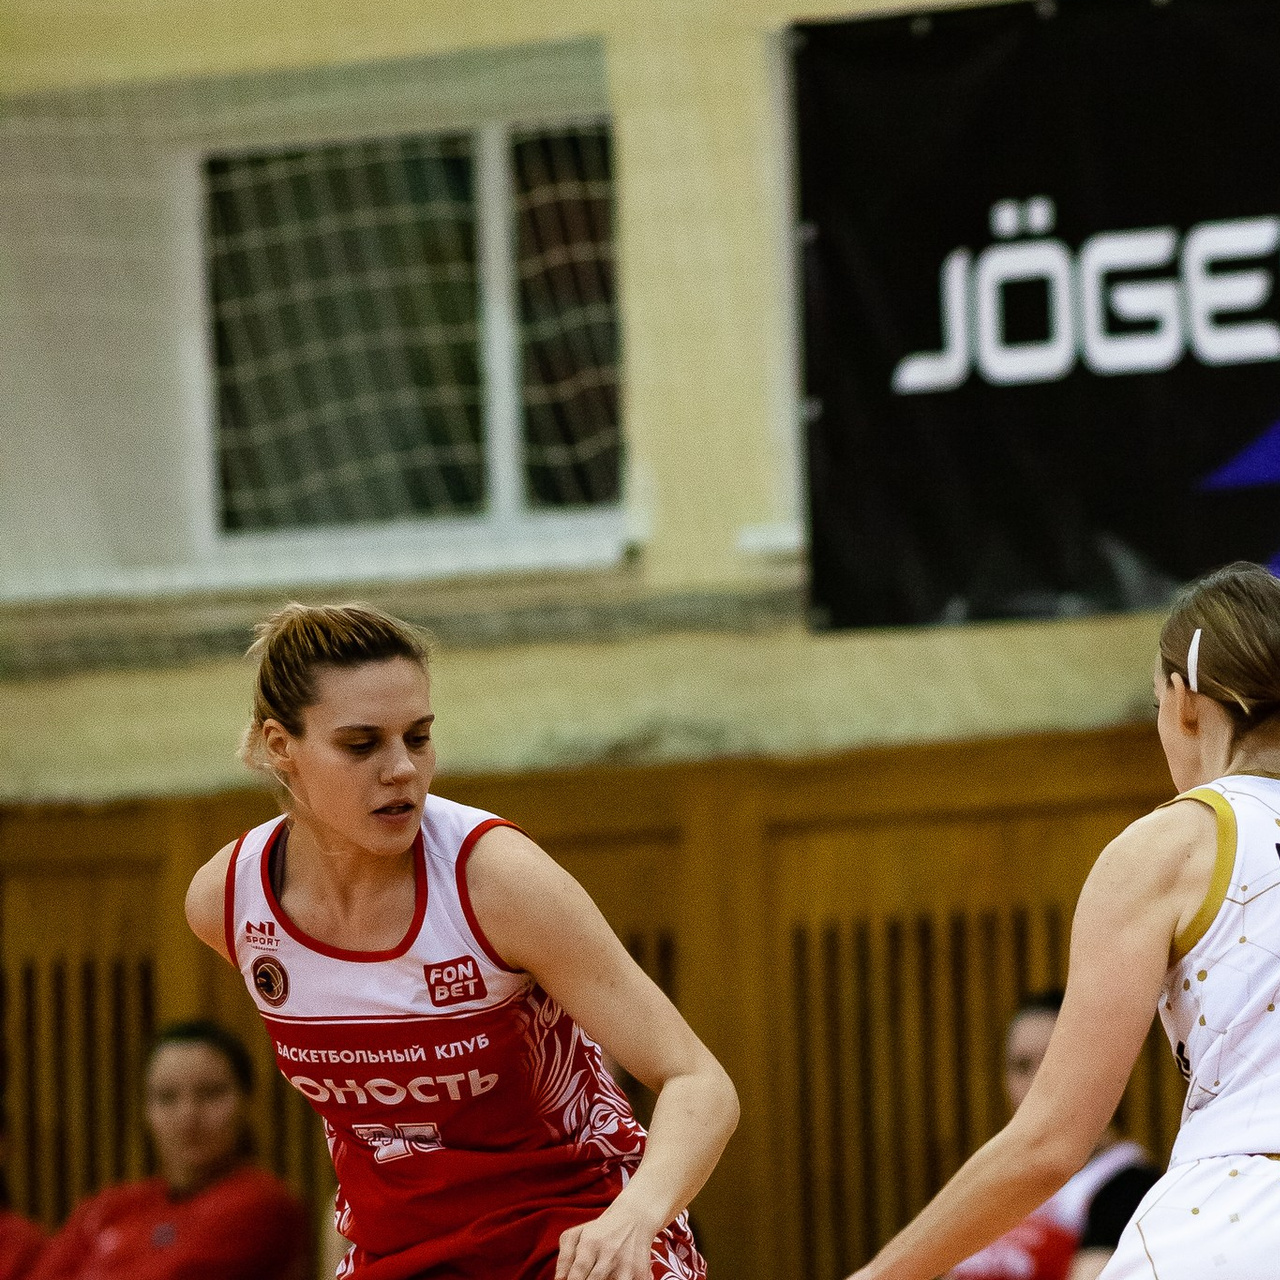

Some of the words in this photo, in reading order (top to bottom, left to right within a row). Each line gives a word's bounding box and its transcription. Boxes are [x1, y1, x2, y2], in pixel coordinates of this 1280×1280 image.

[246, 936, 281, 947] SPORT
[430, 961, 474, 984] FON
[435, 979, 479, 1001] BET
[276, 1041, 427, 1063] БАСКЕТБОЛЬНЫЙ
[434, 1033, 490, 1060] КЛУБ
